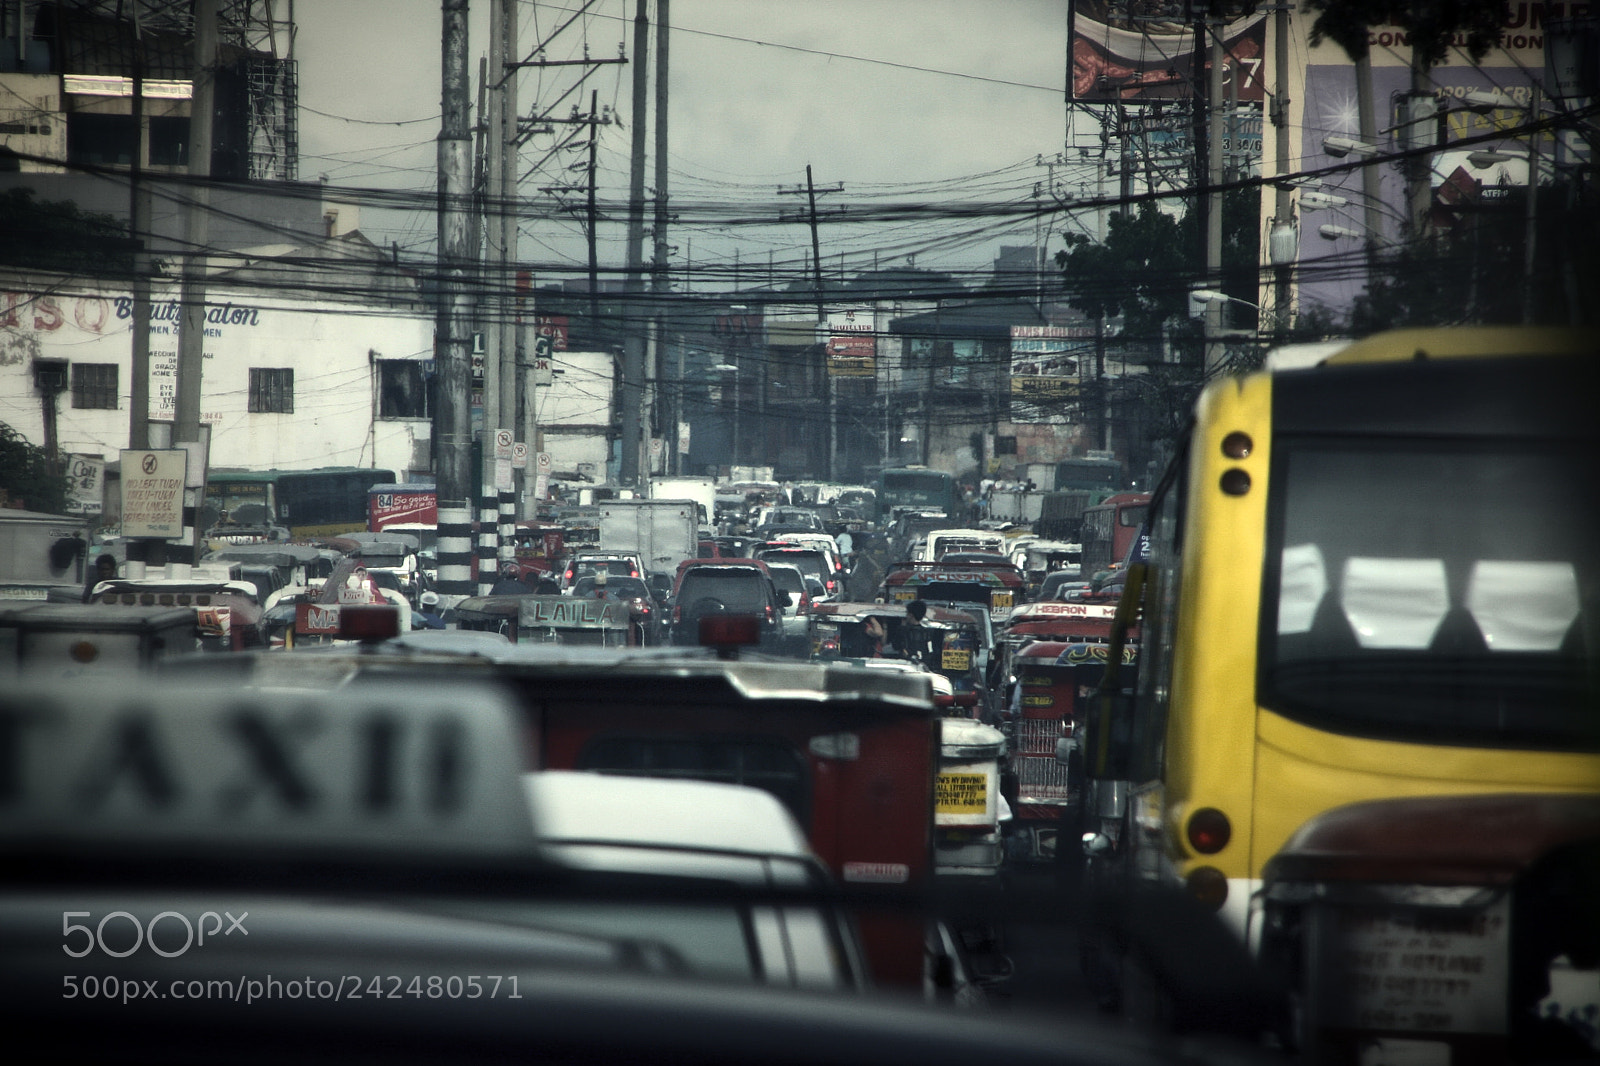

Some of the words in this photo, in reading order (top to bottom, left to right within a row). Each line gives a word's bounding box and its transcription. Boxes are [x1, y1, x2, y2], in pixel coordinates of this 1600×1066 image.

[73, 460, 98, 478] Colt
[160, 479, 181, 490] TURN
[394, 495, 407, 506] So
[534, 601, 614, 624] LAILA
[1035, 605, 1087, 615] HEBRON
